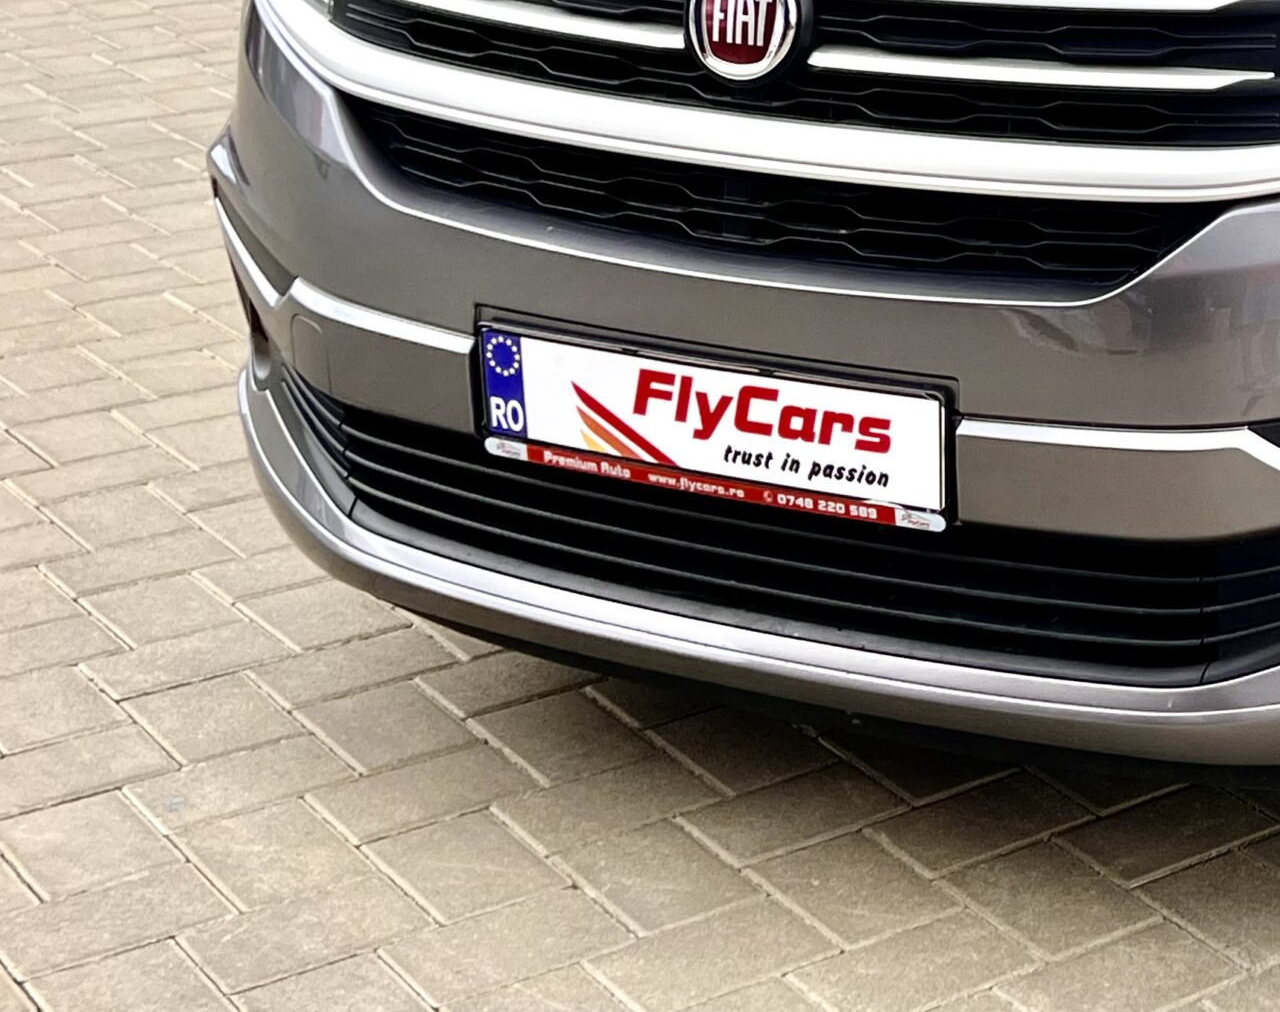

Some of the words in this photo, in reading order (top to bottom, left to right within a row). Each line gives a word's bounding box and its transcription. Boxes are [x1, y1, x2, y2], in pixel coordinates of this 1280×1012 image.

[490, 396, 524, 431] RO
[633, 368, 892, 454] FlyCars
[543, 450, 598, 472] Premium
[601, 462, 631, 478] Auto
[724, 445, 773, 469] trust
[781, 453, 801, 473] in
[808, 461, 889, 487] passion
[648, 473, 745, 498] www.flycars.ro
[777, 494, 813, 509] 0748
[818, 500, 845, 514] 220
